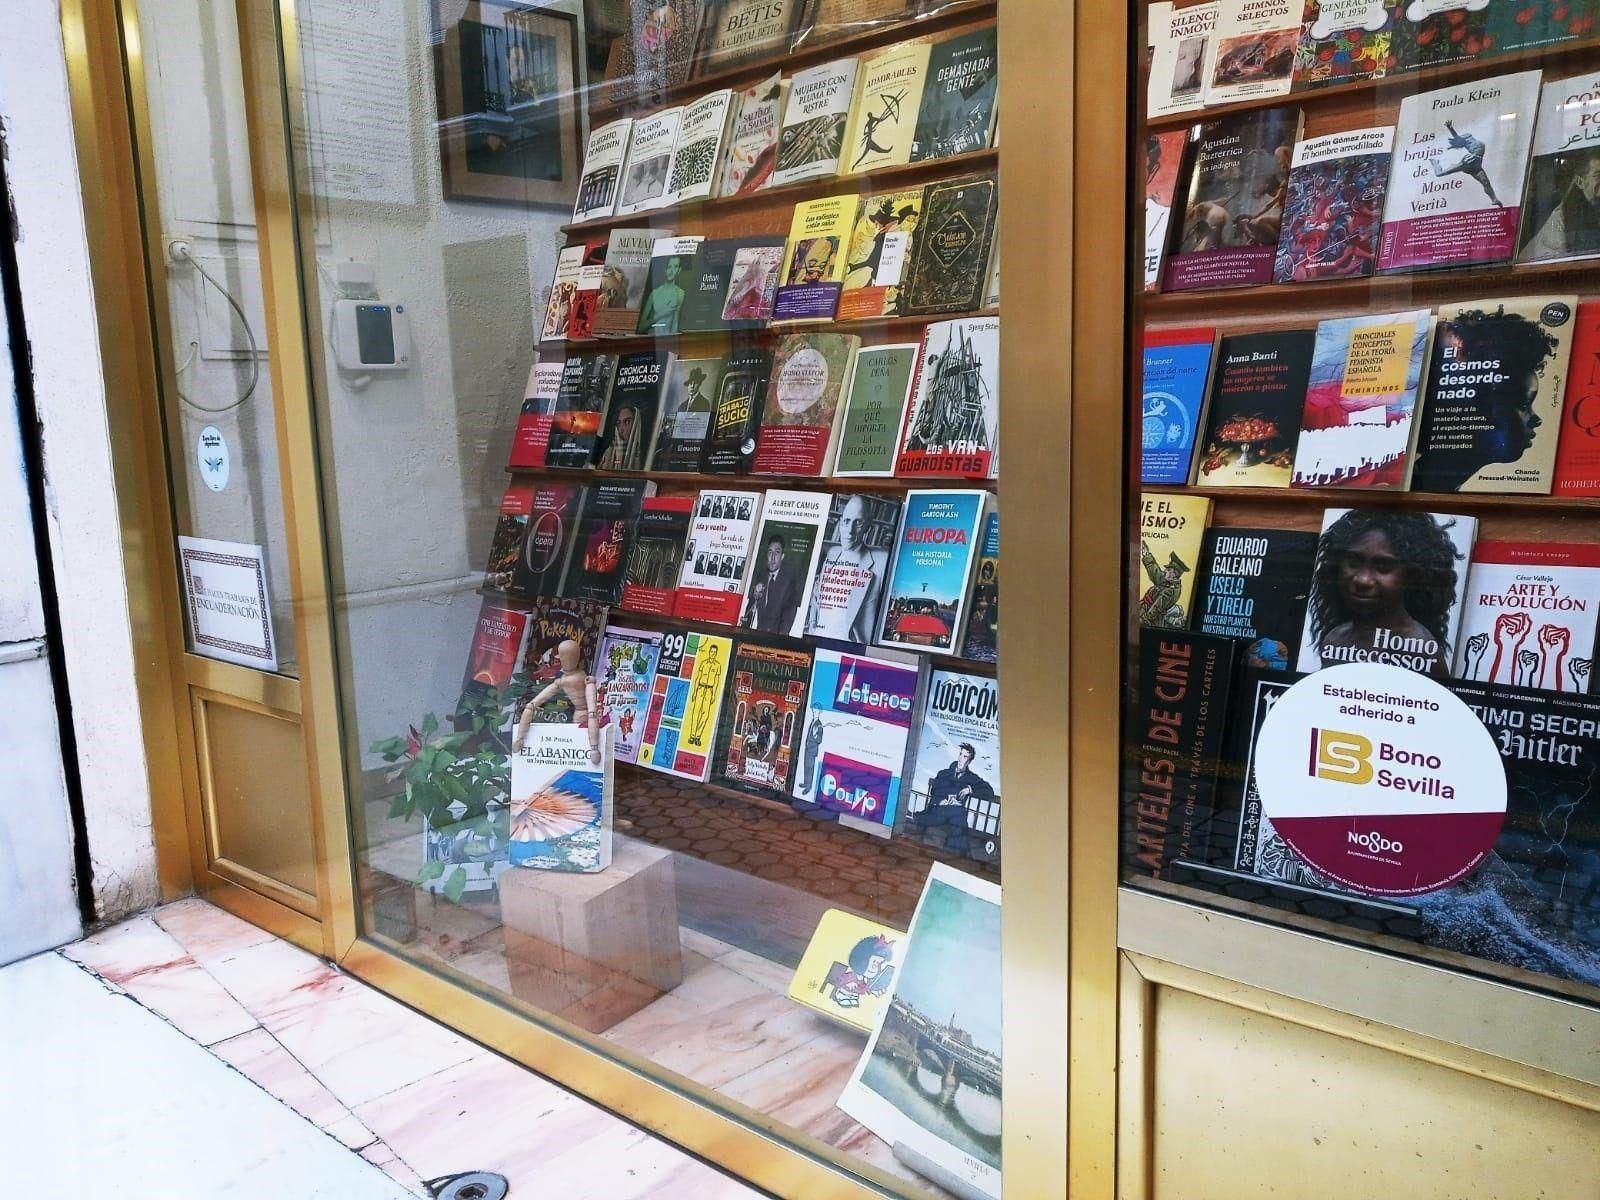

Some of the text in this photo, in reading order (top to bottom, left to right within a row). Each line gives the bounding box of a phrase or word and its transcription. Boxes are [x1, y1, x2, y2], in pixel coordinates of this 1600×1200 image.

[1242, 0, 1287, 12] HIMNOS
[726, 2, 783, 32] BETIS
[1236, 7, 1289, 22] SELECTOS
[1333, 11, 1347, 21] DE
[1170, 21, 1217, 39] INMÓVI
[937, 56, 991, 82] DEMASIADA
[866, 66, 917, 89] ADMIRABLES
[946, 73, 976, 93] GENTE
[794, 74, 848, 97] MUJERES CON
[798, 86, 838, 105] PLUMA EN
[1431, 87, 1502, 111] Paula Klein
[803, 99, 829, 114] RISTRE
[1201, 134, 1240, 151] Agustina
[1332, 134, 1360, 146] Gómez
[1411, 131, 1436, 145] Las
[1199, 146, 1244, 162] Bazterrica
[1301, 141, 1384, 161] El hombre arrodillado
[1403, 147, 1444, 162] brujas
[1209, 160, 1241, 174] indignas
[1412, 165, 1429, 179] de
[1421, 179, 1463, 195] Monte
[1546, 309, 1565, 318] PEN
[1353, 330, 1397, 341] PRINCIPALES
[1352, 339, 1393, 350] CONCEPTOS
[1226, 350, 1278, 364] Anna Banti
[1350, 346, 1396, 358] DE LA TEORÍA
[1442, 346, 1459, 359] El
[868, 356, 898, 367] CARLOS
[1349, 357, 1384, 367] FEMINISTA
[1441, 359, 1501, 373] cosmos
[619, 364, 661, 377] CRÓNICA DE
[870, 367, 890, 377] PEÑA
[1347, 365, 1382, 375] ESPAÑOLA
[617, 374, 659, 386] UN FRACASO
[1438, 371, 1510, 386] desorde-
[1260, 383, 1288, 393] pintar
[1345, 385, 1400, 395] FEMINISMOS
[1437, 387, 1477, 400] nado
[719, 399, 749, 414] TRABAJO
[866, 401, 882, 410] POR
[1446, 406, 1463, 415] viaje
[718, 407, 749, 425] SUCIO
[864, 411, 880, 422] QUÉ
[1461, 415, 1487, 423] oscura,
[853, 423, 887, 433] IMPORTA
[1440, 424, 1496, 432] espacio-tiempo
[862, 436, 872, 444] LA
[1429, 442, 1473, 451] postergados
[845, 445, 887, 456] FILOSOFÍA
[925, 444, 943, 455] LOS
[772, 499, 820, 510] ALBERT CAMUS
[928, 503, 955, 511] TIMOTHY
[1157, 501, 1173, 514] EL
[921, 510, 959, 519] GARTON ASH
[709, 524, 728, 532] vuelta
[1142, 515, 1186, 530] ISMO?
[904, 527, 968, 545] EUROPA
[1215, 536, 1269, 557] EDUARDO
[912, 550, 952, 559] UNA HISTORIA
[915, 559, 944, 567] PERSONAL
[1212, 556, 1263, 577] GALEANO
[823, 566, 873, 579] La saga de los
[1515, 574, 1554, 583] César Vallejo
[821, 575, 866, 588] intelectuales
[1209, 575, 1245, 596] ÚSELO
[820, 584, 852, 596] franceses
[1507, 583, 1561, 597] ARTE Y
[1217, 594, 1254, 617] TÍRELO
[1479, 593, 1587, 612] REVOLUCIÓN
[1203, 614, 1227, 626] NUESTRO
[1202, 625, 1257, 639] NUESTRA CASA
[663, 634, 684, 658] 99
[1373, 627, 1439, 656] Homo
[1321, 642, 1438, 674] antecessor
[1154, 640, 1193, 703] CINE
[1200, 648, 1218, 698] CARTELES
[932, 680, 999, 722] LOGICÓM
[1323, 684, 1440, 712] Establecimiento
[1492, 692, 1509, 700] FABIO
[1552, 699, 1582, 709] MASSIMO
[1198, 700, 1210, 723] LOS
[1339, 703, 1416, 725] adherido a
[1469, 704, 1525, 729] TIMO
[1148, 707, 1182, 745] DE
[1195, 722, 1206, 737] DE
[520, 746, 535, 758] EL
[1498, 728, 1583, 767] Hitler
[1379, 742, 1442, 770] Bono
[1377, 769, 1456, 800] Sevilla
[820, 773, 877, 817] Polyp
[1184, 792, 1197, 817] CINE
[1136, 757, 1177, 879] ARTELES
[1183, 818, 1194, 840] DEL
